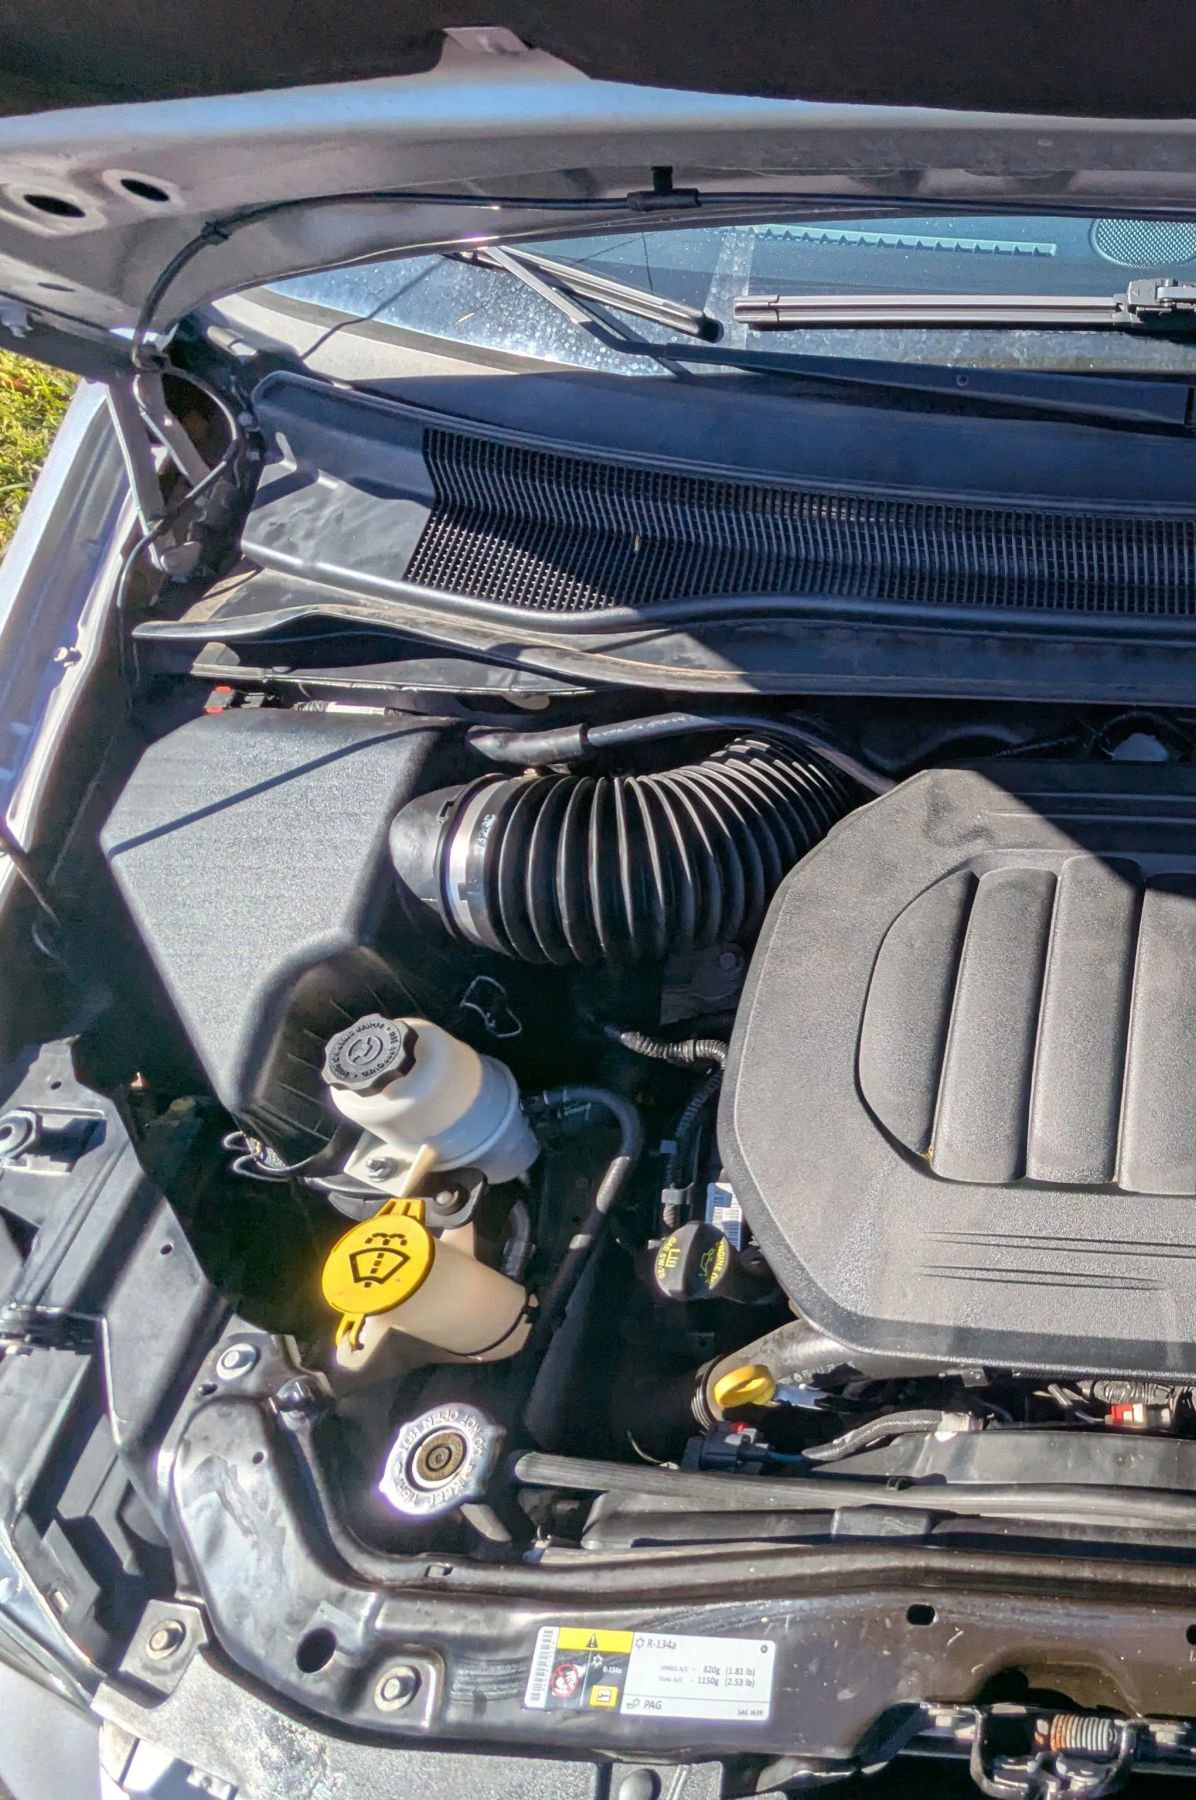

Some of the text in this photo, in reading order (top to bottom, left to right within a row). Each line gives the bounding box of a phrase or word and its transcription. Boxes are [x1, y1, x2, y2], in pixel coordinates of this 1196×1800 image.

[647, 1639, 677, 1650] R-134a
[702, 1665, 721, 1676] 820g
[697, 1676, 720, 1687] 1150g
[724, 1677, 743, 1688] (2.53
[745, 1678, 755, 1688] lb)
[644, 1700, 662, 1710] PAG
